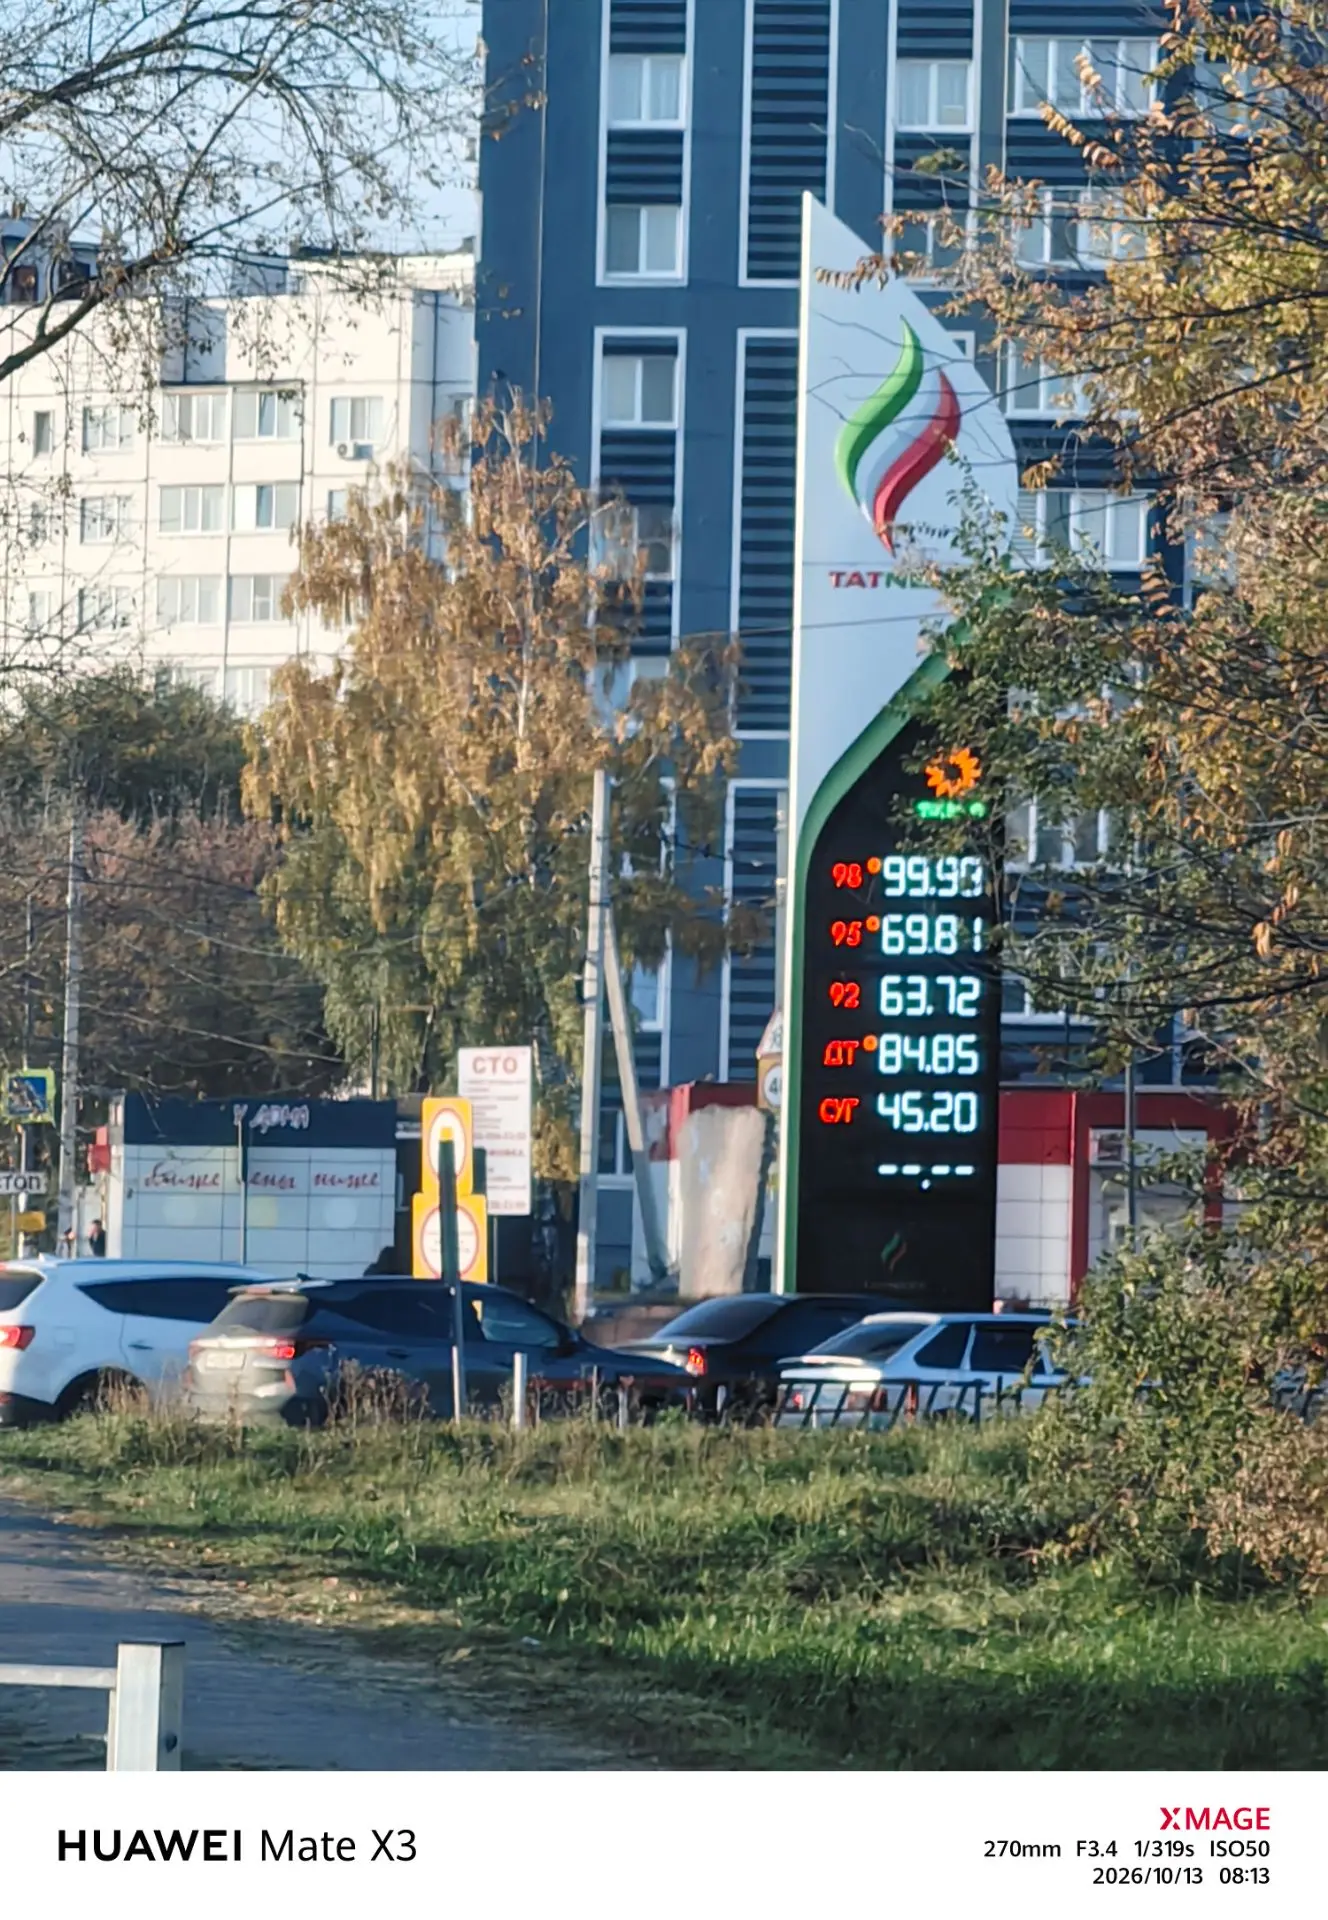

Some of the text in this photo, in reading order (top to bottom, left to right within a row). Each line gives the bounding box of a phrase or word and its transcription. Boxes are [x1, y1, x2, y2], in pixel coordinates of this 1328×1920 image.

[828, 571, 932, 588] TATNE
[832, 863, 862, 888] 98
[831, 914, 982, 955] 95 69.81
[829, 976, 980, 1016] 92 63.72
[472, 1056, 518, 1074] СТО
[823, 1034, 979, 1074] ДТ 84.85
[818, 1091, 977, 1132] СУГ 45.20
